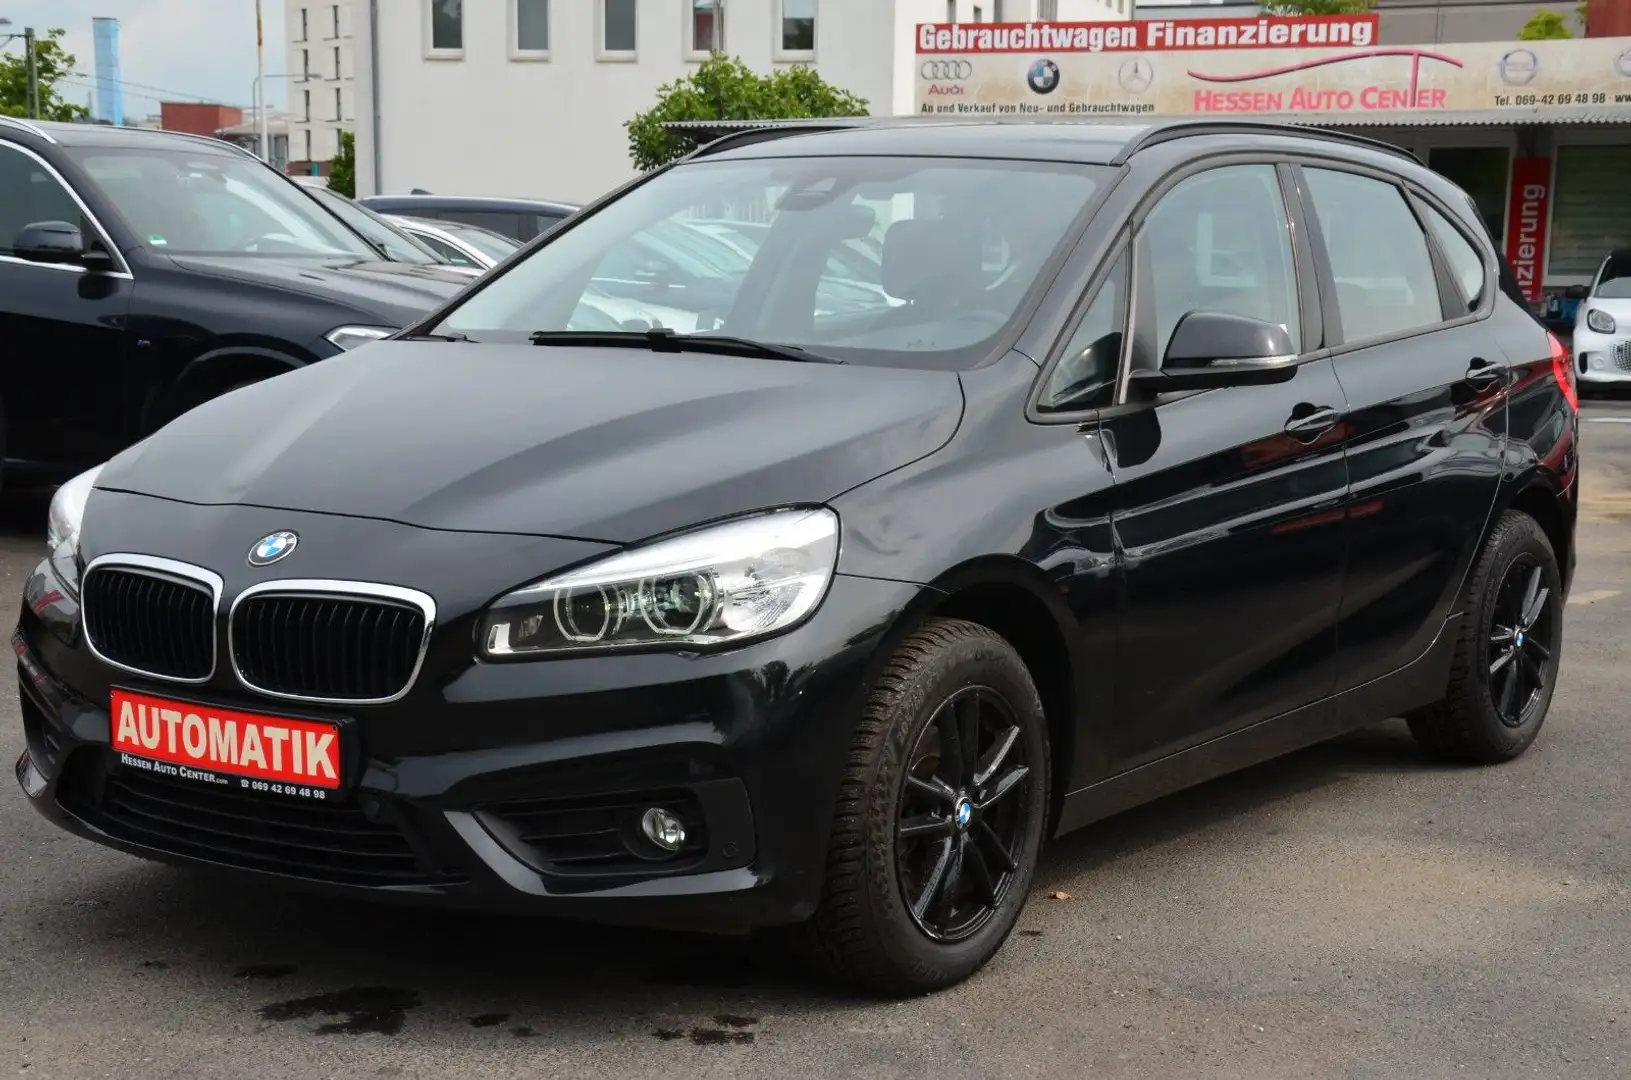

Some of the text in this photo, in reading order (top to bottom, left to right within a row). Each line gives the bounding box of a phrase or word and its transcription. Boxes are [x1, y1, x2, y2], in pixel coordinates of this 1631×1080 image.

[920, 20, 1372, 52] Gebrauchtwagen Finanzierung
[928, 84, 964, 95] Audi
[1193, 90, 1283, 112] HESSEN
[1289, 87, 1354, 110] AUTO
[1495, 95, 1512, 106] Tel.
[1516, 94, 1554, 105] 069-42
[1558, 94, 1572, 104] 69
[1575, 93, 1589, 103] 48
[1592, 93, 1606, 103] 98
[921, 102, 1155, 114] An und Verkauf von Neu- und Gebrauchtwagen
[1512, 184, 1546, 301] nzierung
[117, 701, 337, 779] AUTOMATIK
[121, 753, 152, 770] HESSEN
[153, 761, 177, 776] AUTO
[252, 781, 326, 800] 069 42 69 48 98
